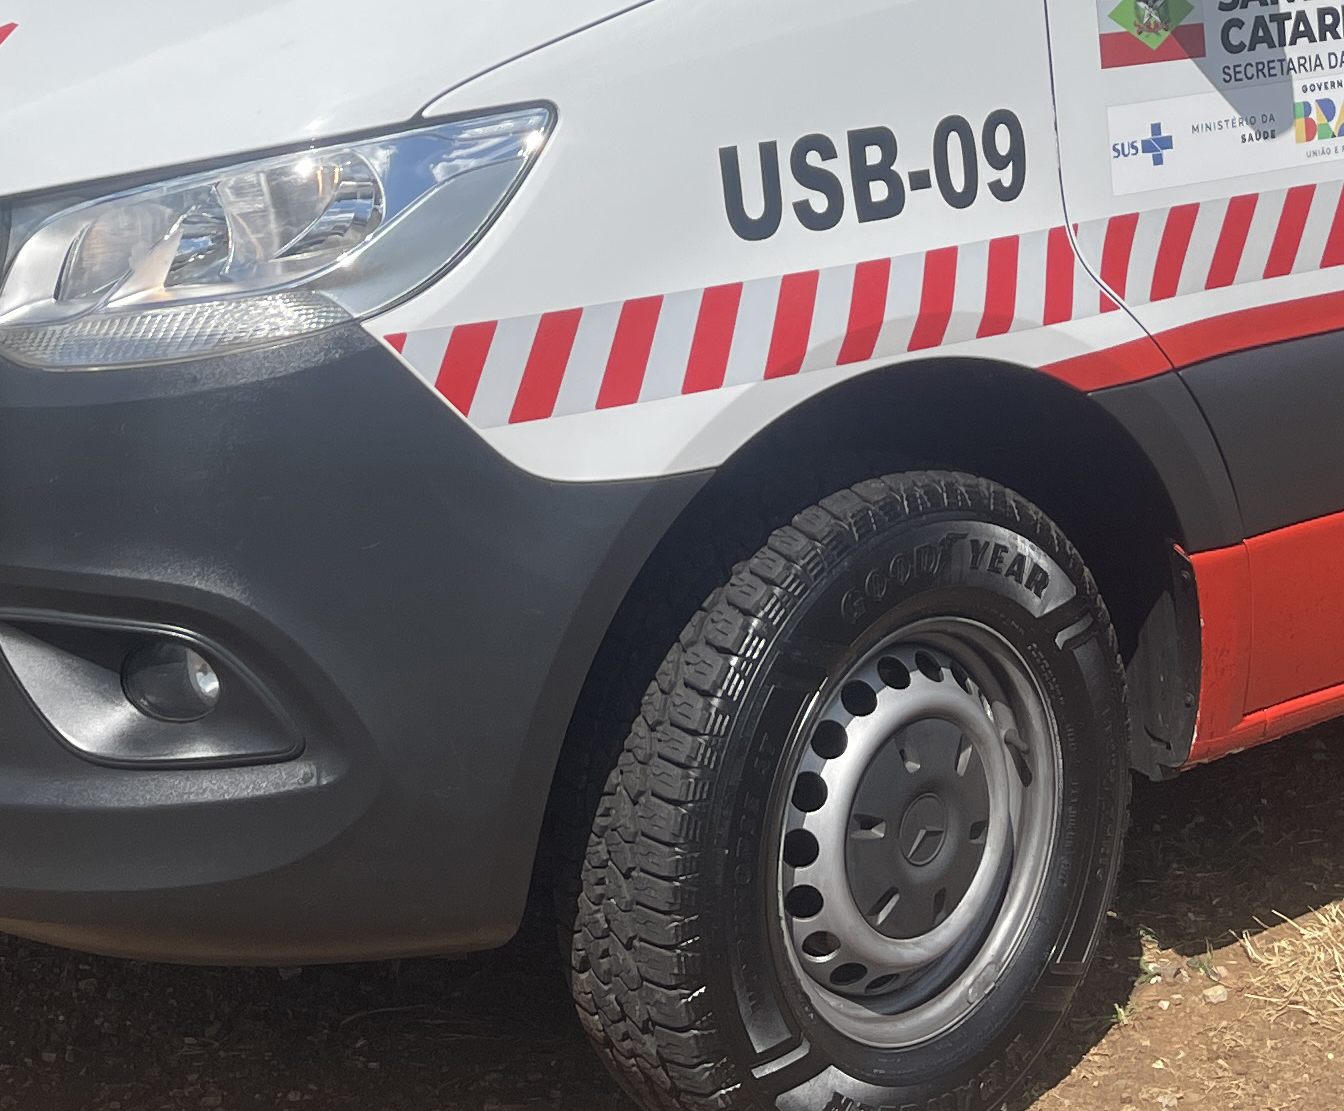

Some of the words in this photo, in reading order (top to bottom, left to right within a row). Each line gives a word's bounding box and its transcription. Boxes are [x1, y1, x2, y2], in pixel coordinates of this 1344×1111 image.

[1222, 53, 1325, 84] SECRETARIA
[1191, 115, 1256, 134] MINISTÉRIO
[1261, 113, 1275, 124] DA
[1241, 129, 1276, 144] SAÚDE
[1112, 139, 1139, 158] SUS
[1306, 146, 1331, 158] UNIÃO
[1334, 146, 1339, 154] E
[718, 108, 1026, 241] USB-09
